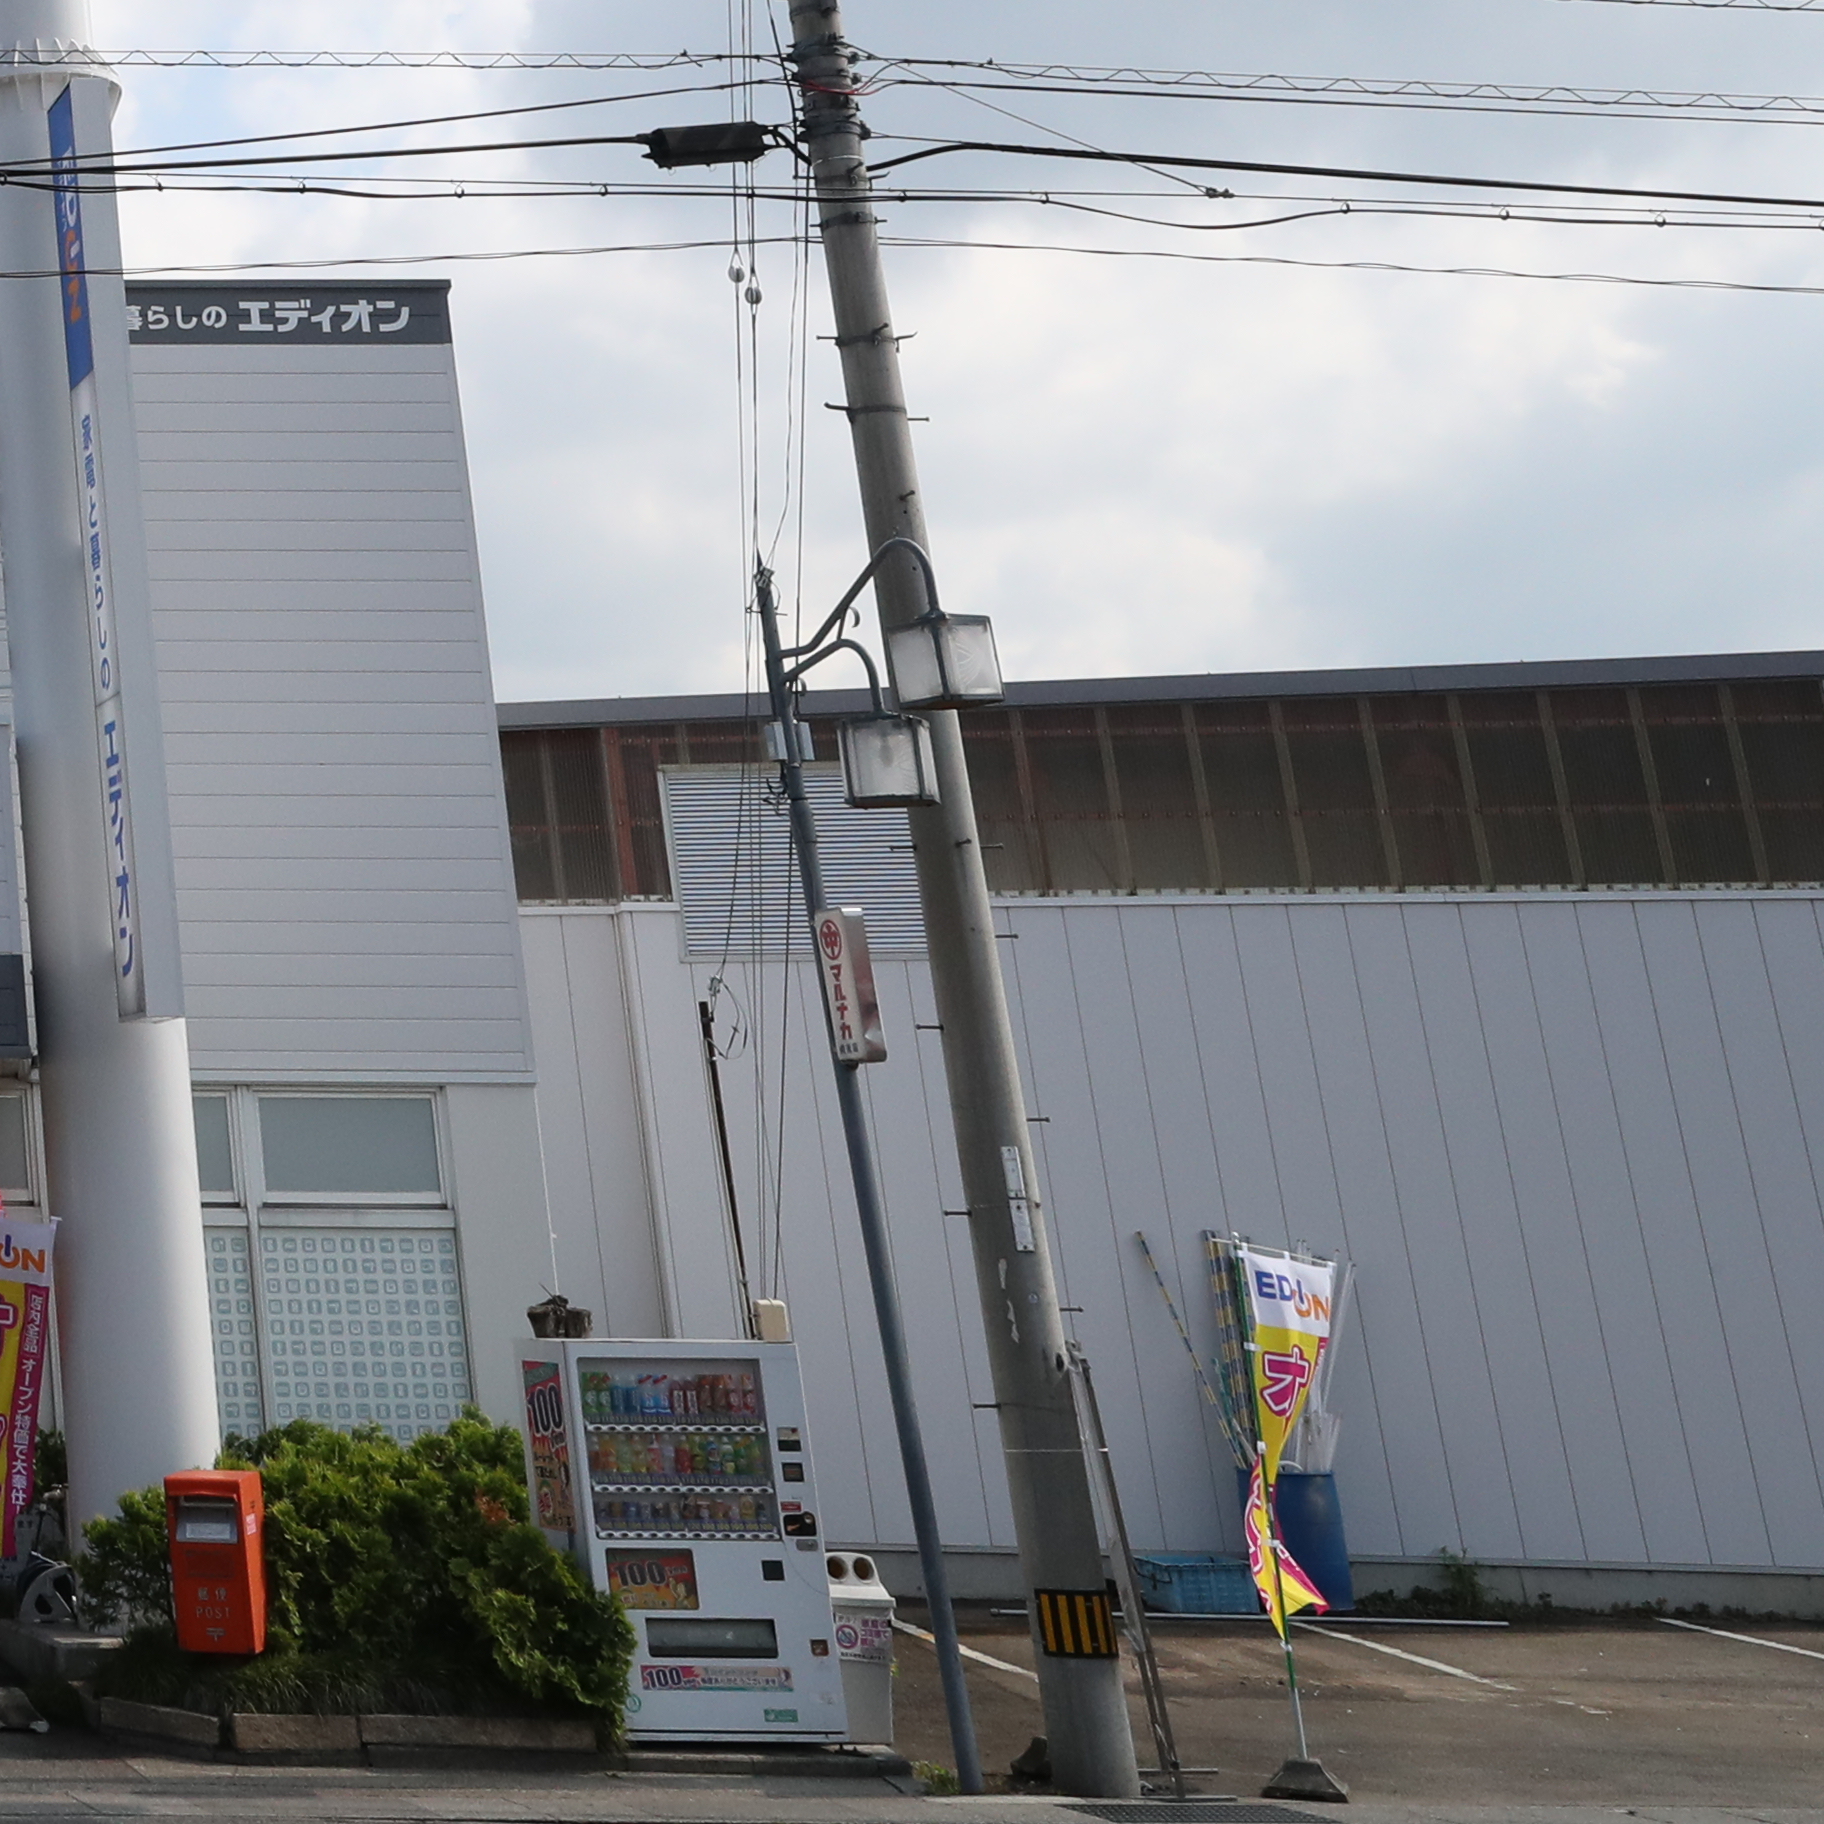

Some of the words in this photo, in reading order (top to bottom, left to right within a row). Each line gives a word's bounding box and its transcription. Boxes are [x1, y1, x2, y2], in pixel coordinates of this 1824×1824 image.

[238, 300, 409, 333] エディオン
[103, 720, 133, 978] エディオン
[829, 963, 853, 1041] マルナカ
[1254, 1270, 1331, 1321] EDION
[526, 1382, 564, 1438] 100
[612, 1560, 667, 1588] 100
[196, 1607, 231, 1619] POST
[646, 1667, 683, 1689] 100
